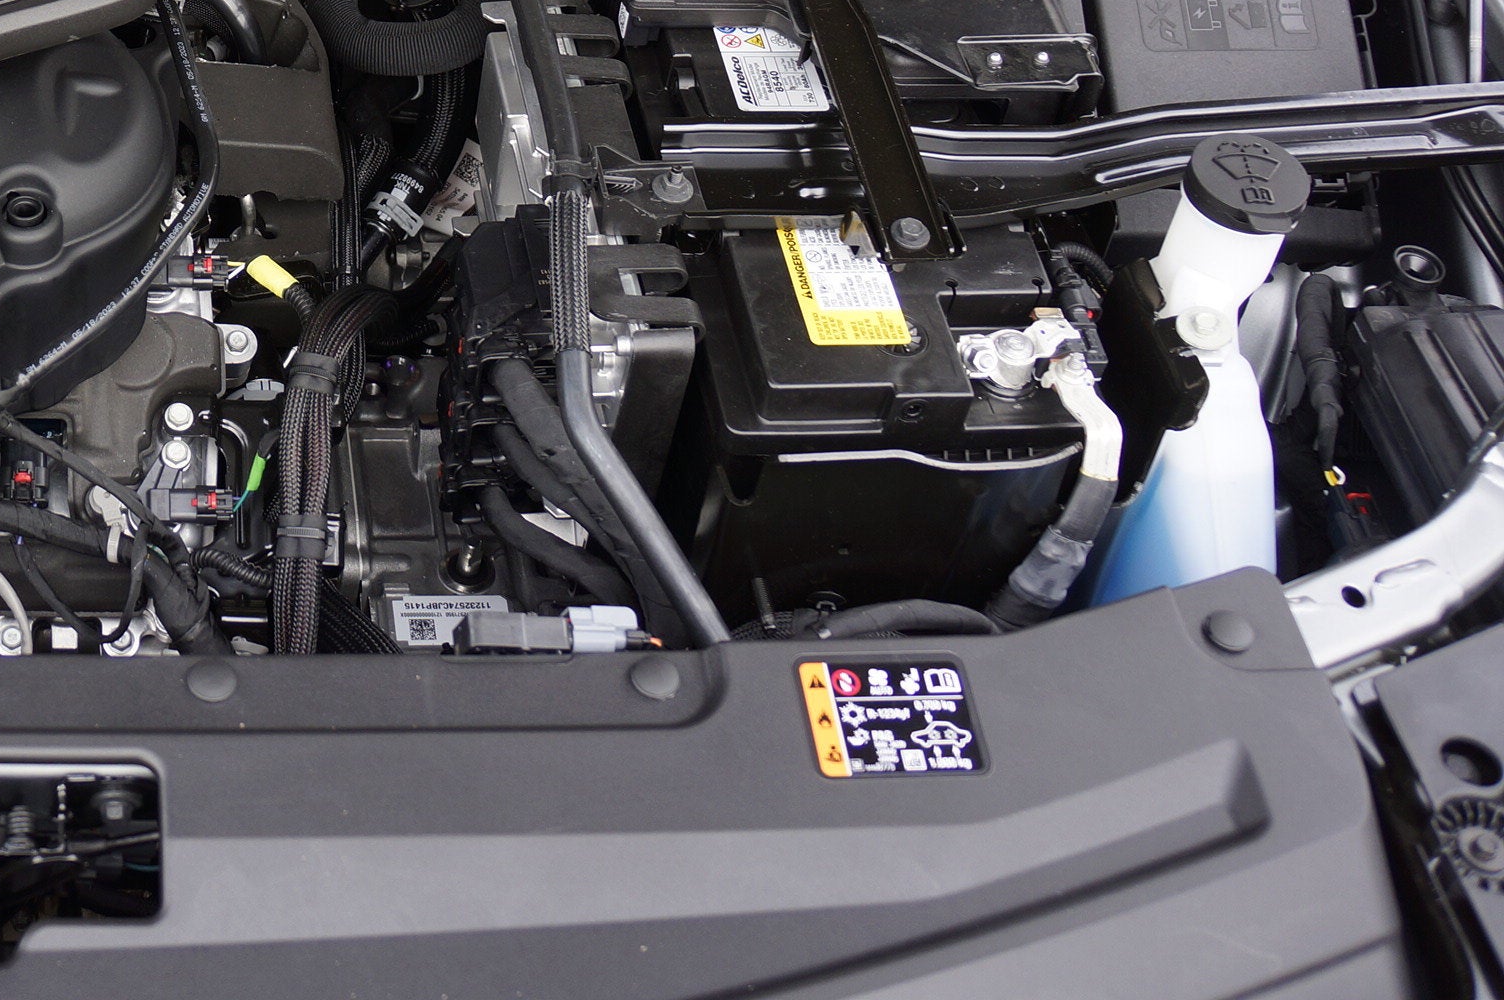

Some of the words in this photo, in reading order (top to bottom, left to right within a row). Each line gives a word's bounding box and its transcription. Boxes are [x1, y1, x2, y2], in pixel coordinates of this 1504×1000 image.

[176, 41, 195, 80] 05/18/2023
[731, 56, 754, 105] ACDelco
[770, 70, 784, 93] 8540
[71, 301, 117, 340] 05/18/2023
[159, 222, 183, 250] STANDARD
[183, 182, 209, 222] AUTOMOTIVE
[404, 601, 492, 610] 11232574CJBP1415
